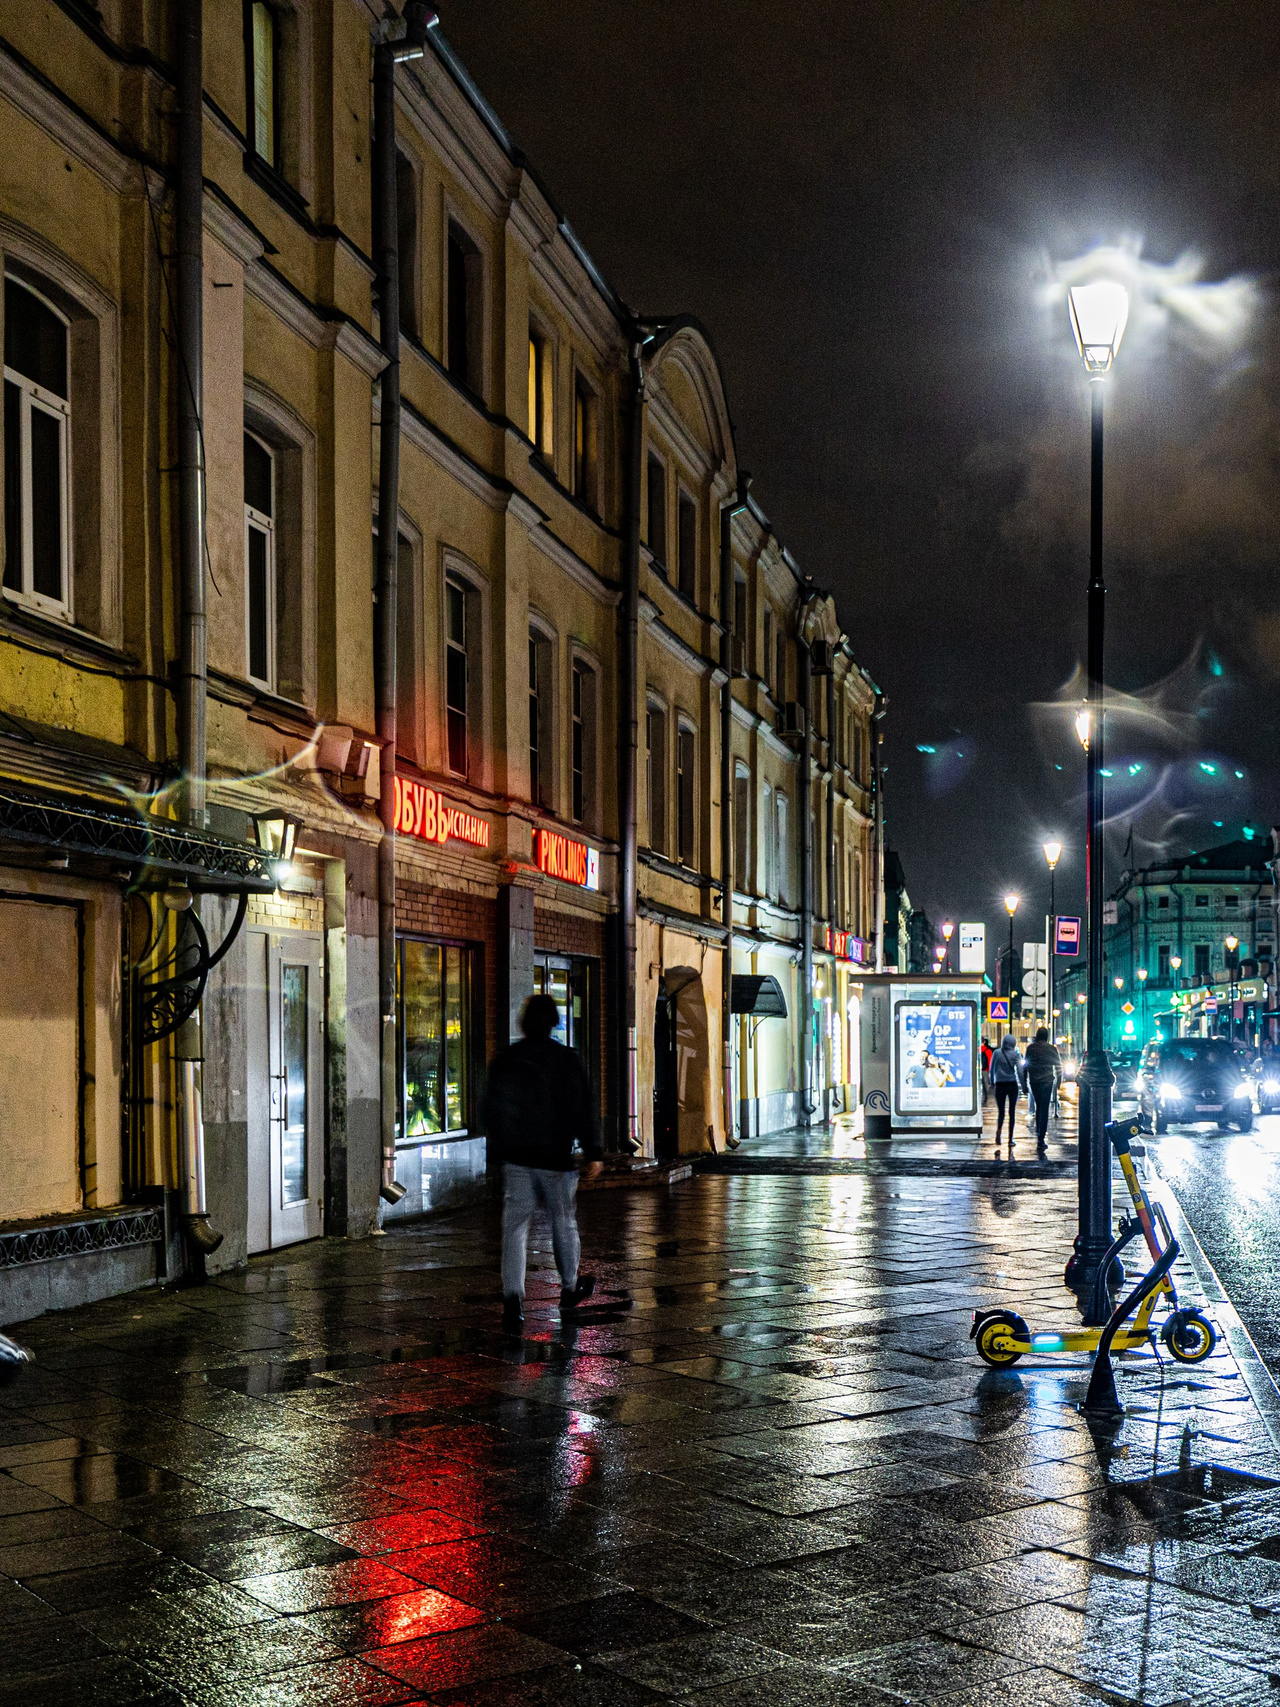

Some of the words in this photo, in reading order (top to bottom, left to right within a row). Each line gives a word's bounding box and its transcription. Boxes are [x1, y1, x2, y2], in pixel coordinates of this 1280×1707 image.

[447, 808, 489, 848] ИСПАНИИ
[541, 829, 587, 886] PIKOLINOS
[948, 1011, 965, 1019] ВТБ
